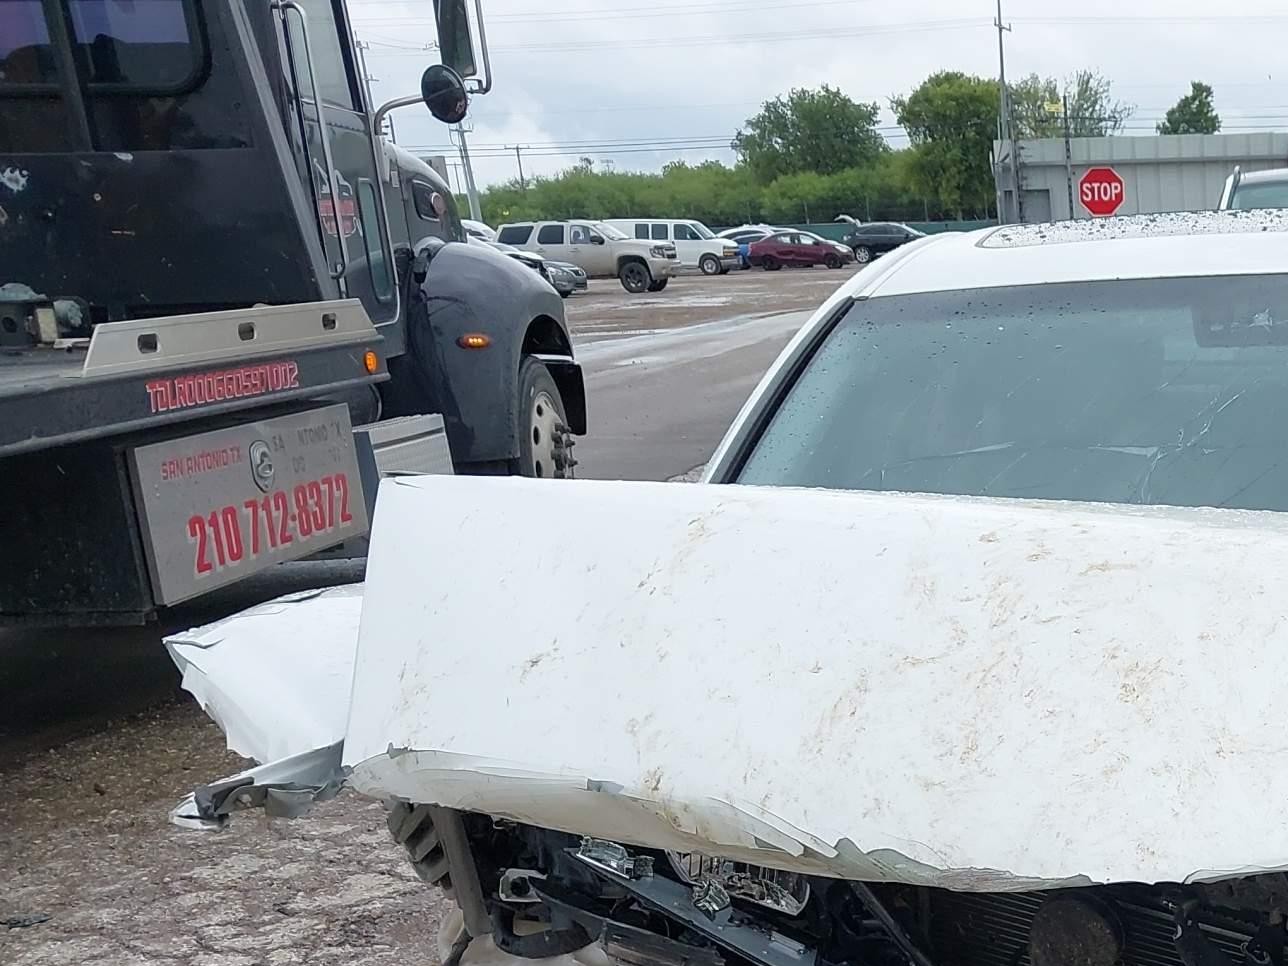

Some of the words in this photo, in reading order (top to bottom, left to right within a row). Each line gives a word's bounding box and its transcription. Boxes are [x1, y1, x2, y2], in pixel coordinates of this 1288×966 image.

[1082, 182, 1121, 201] STOP
[161, 460, 184, 480] SAN
[186, 448, 227, 475] ANTONIO
[188, 505, 243, 574] 210
[244, 473, 353, 555] 712-8372
